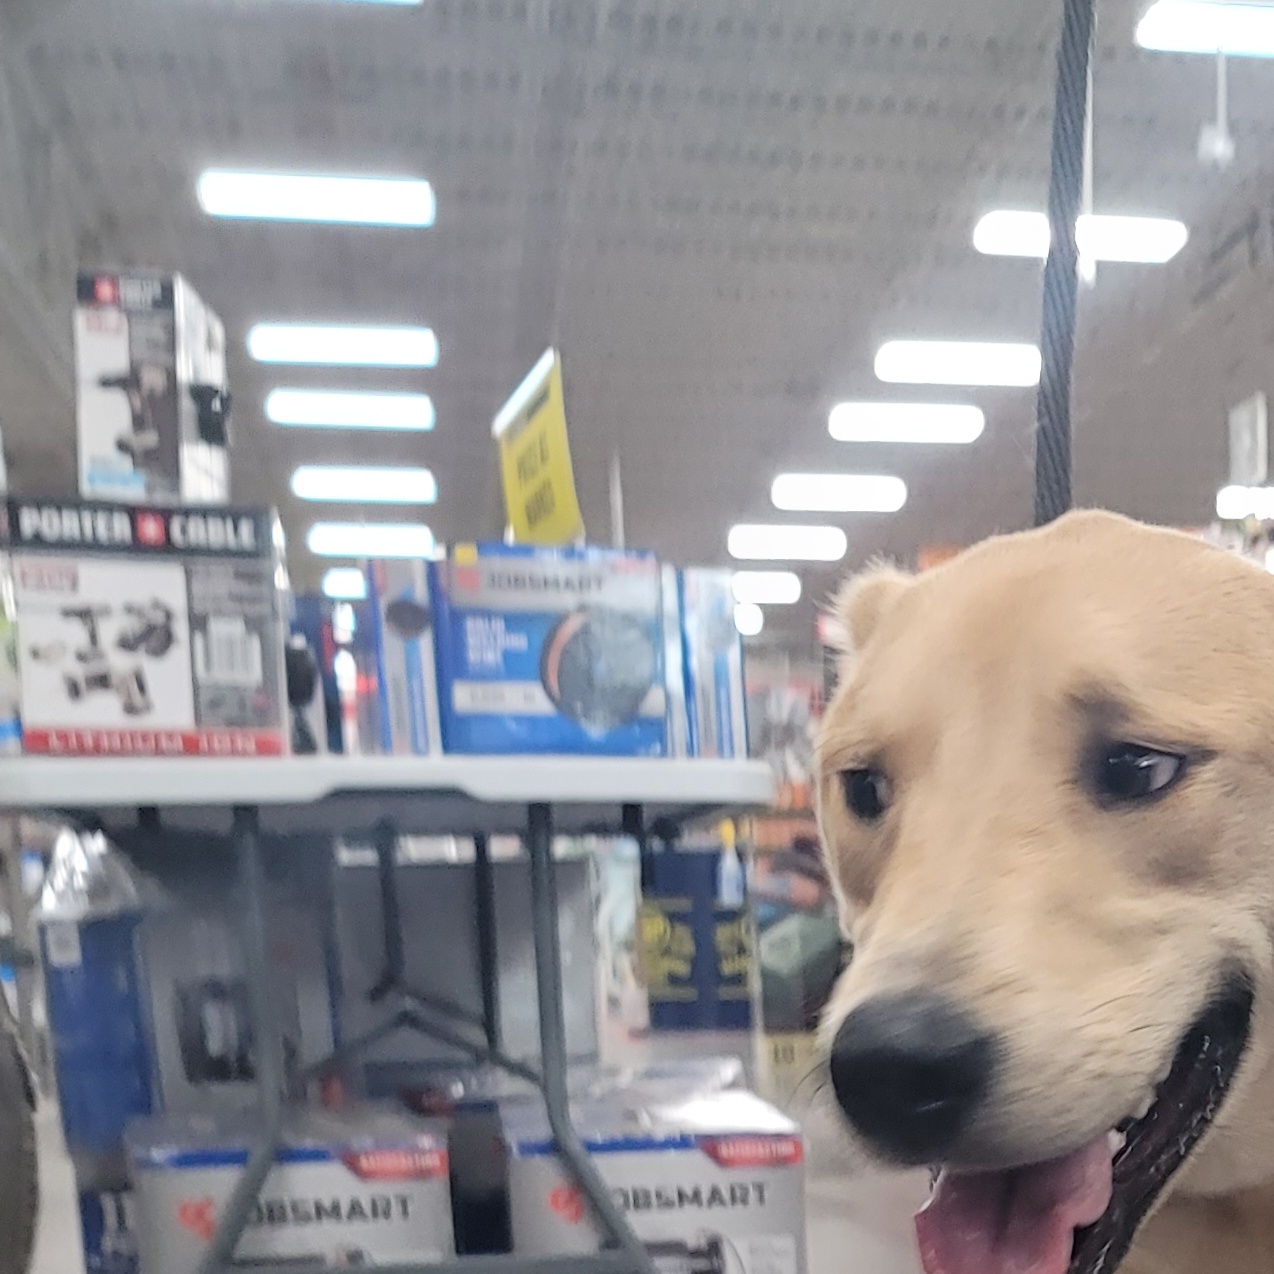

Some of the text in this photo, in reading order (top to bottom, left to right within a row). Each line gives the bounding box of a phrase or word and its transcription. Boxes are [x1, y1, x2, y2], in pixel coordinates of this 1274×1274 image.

[19, 505, 255, 552] PORTER CABLE
[49, 729, 184, 753] LITHIUM
[255, 1194, 410, 1224] OBSMART
[616, 1181, 766, 1211] OBSMART
